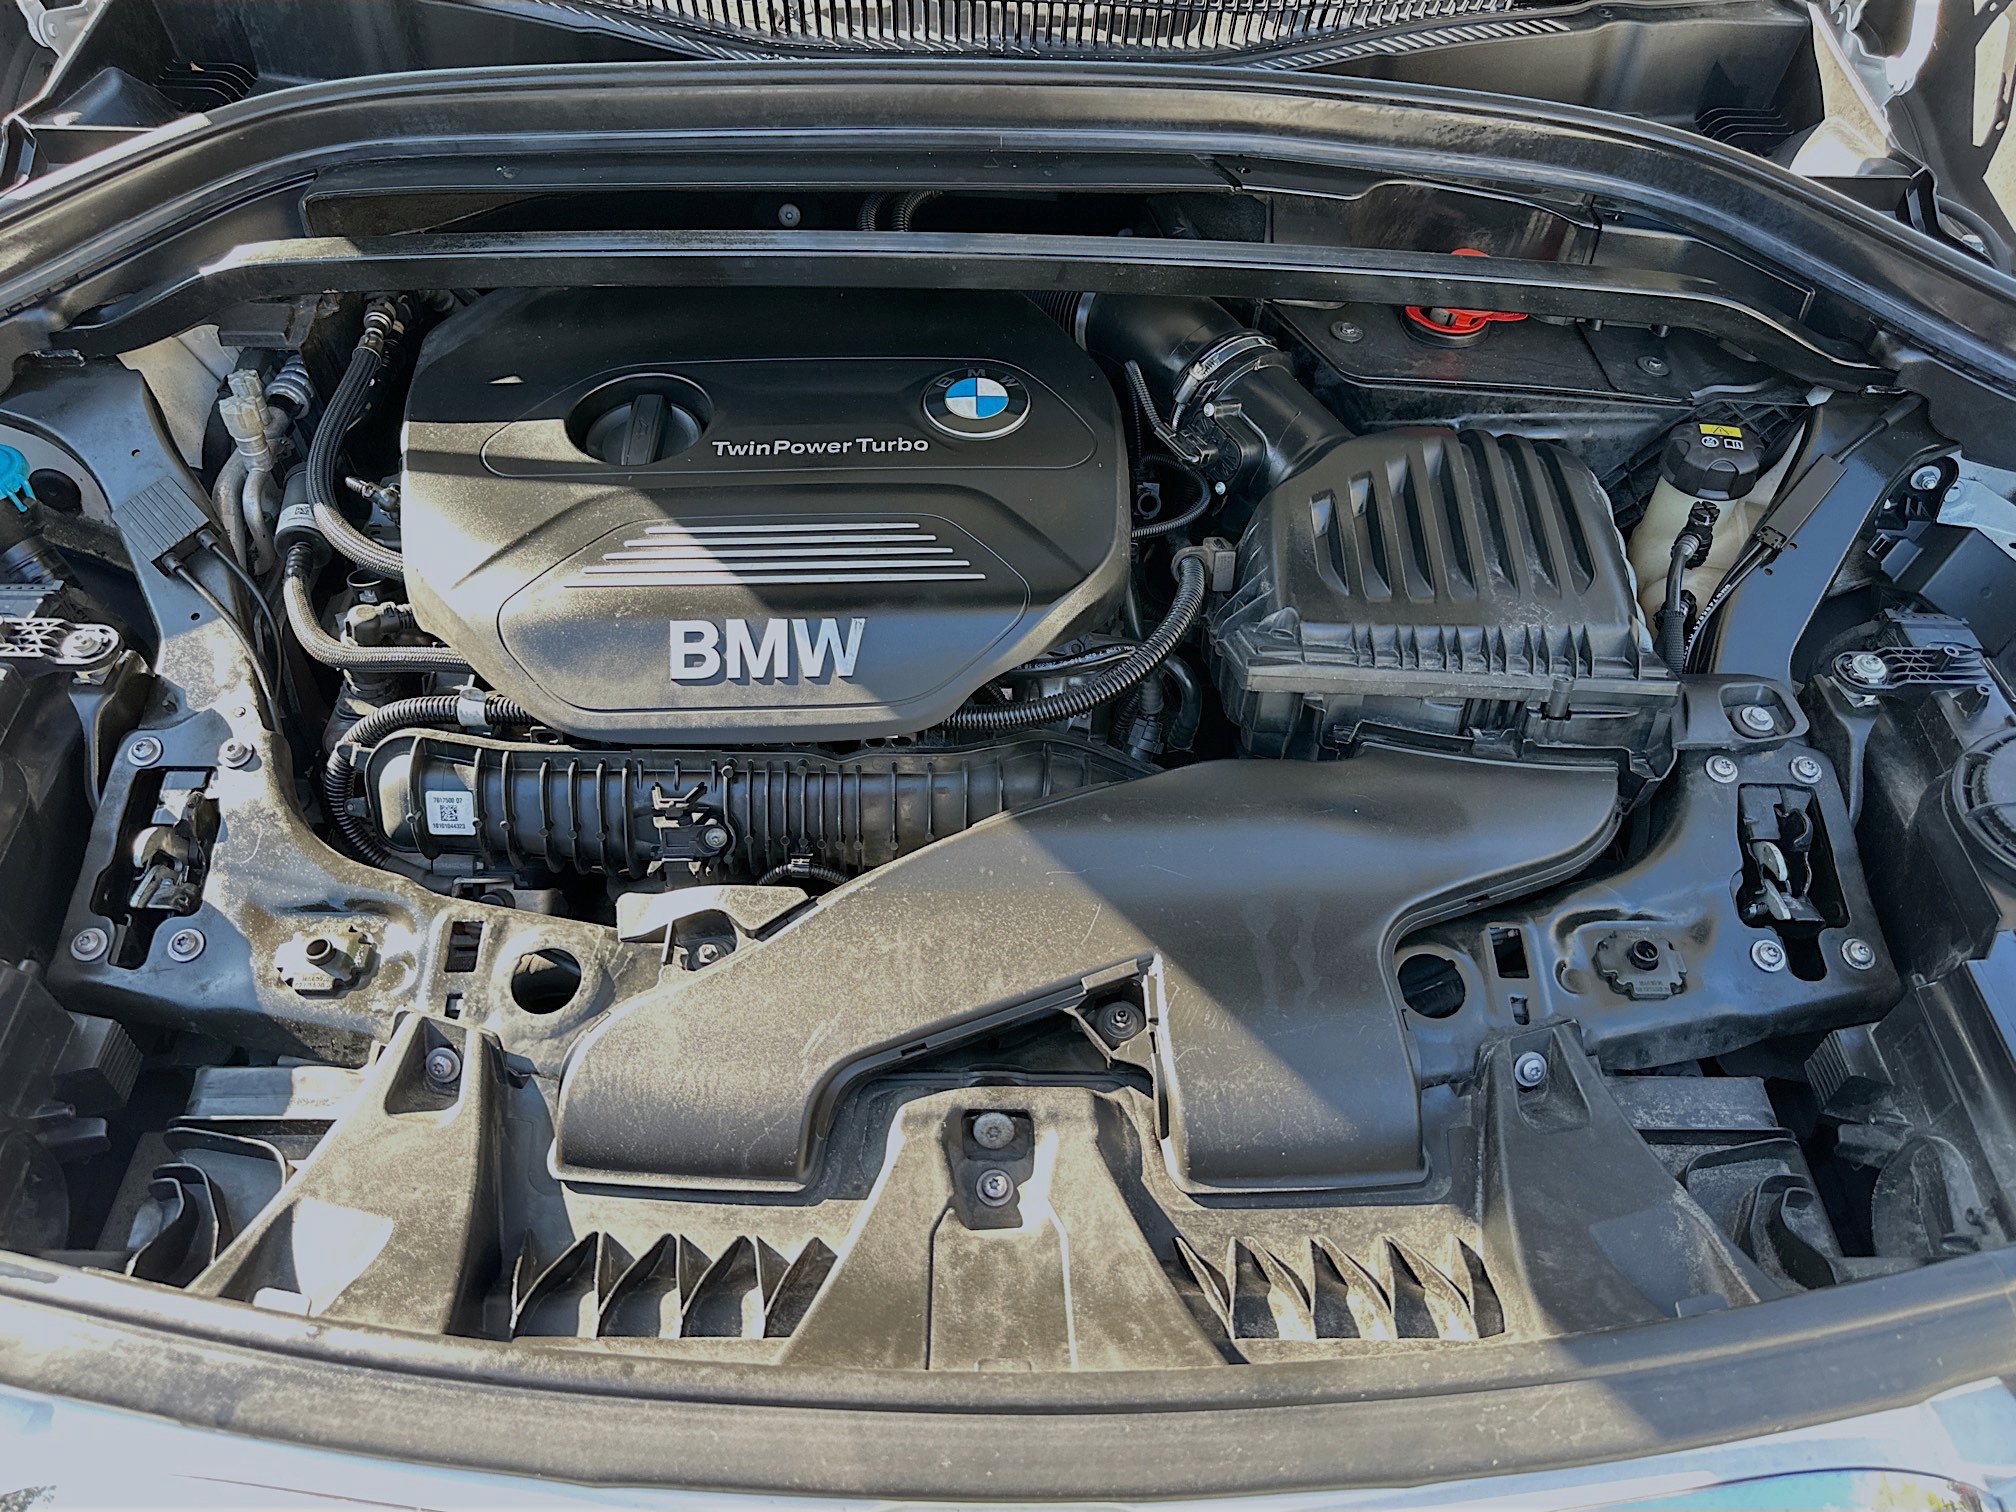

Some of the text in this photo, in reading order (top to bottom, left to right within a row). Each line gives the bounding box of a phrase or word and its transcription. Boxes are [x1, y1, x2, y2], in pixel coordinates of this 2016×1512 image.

[935, 368, 1020, 388] BMW
[712, 437, 929, 456] TwinPower Turbo
[669, 618, 866, 680] BMW
